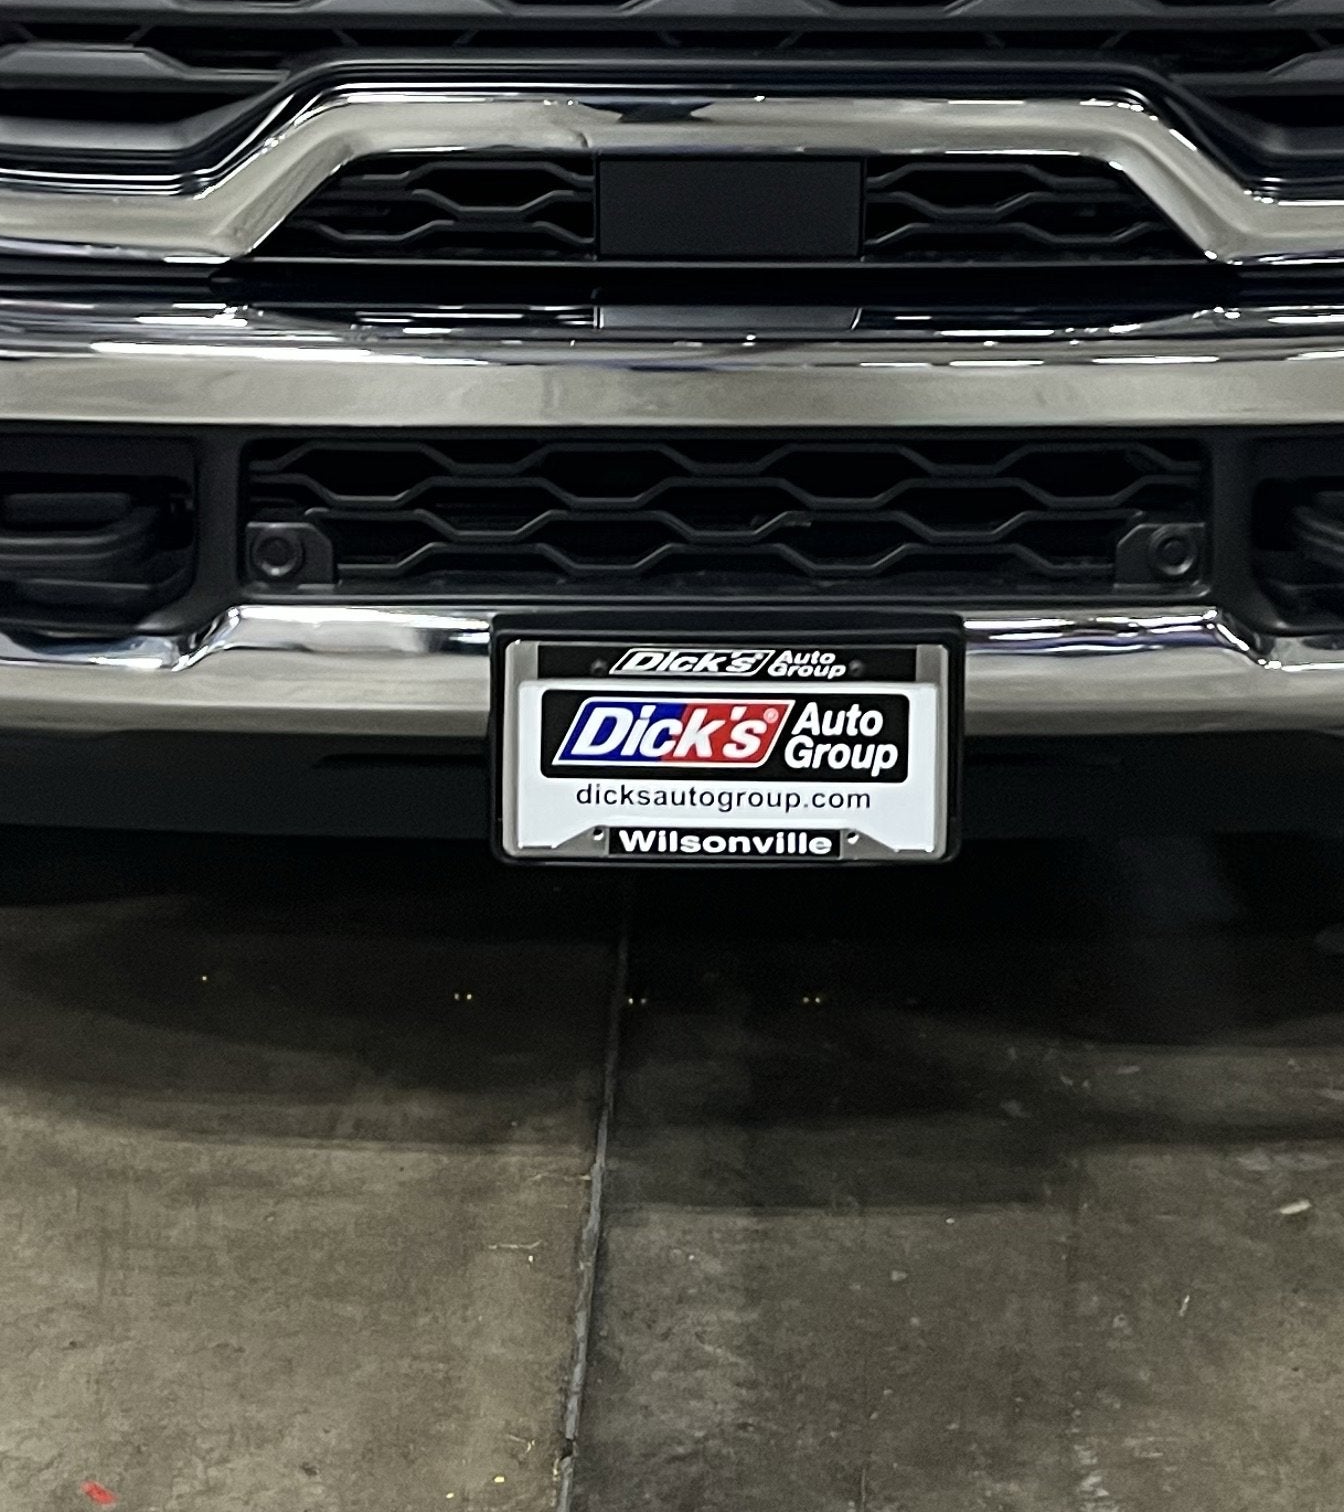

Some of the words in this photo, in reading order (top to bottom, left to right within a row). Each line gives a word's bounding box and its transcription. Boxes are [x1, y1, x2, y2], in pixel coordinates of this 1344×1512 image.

[767, 663, 847, 679] Group
[779, 650, 836, 664] Auto
[570, 704, 768, 759] Dick's
[791, 701, 884, 737] Auto
[783, 735, 899, 777] Group
[575, 783, 872, 813] dicksautogroup.com
[618, 829, 834, 855] Wilsonville
